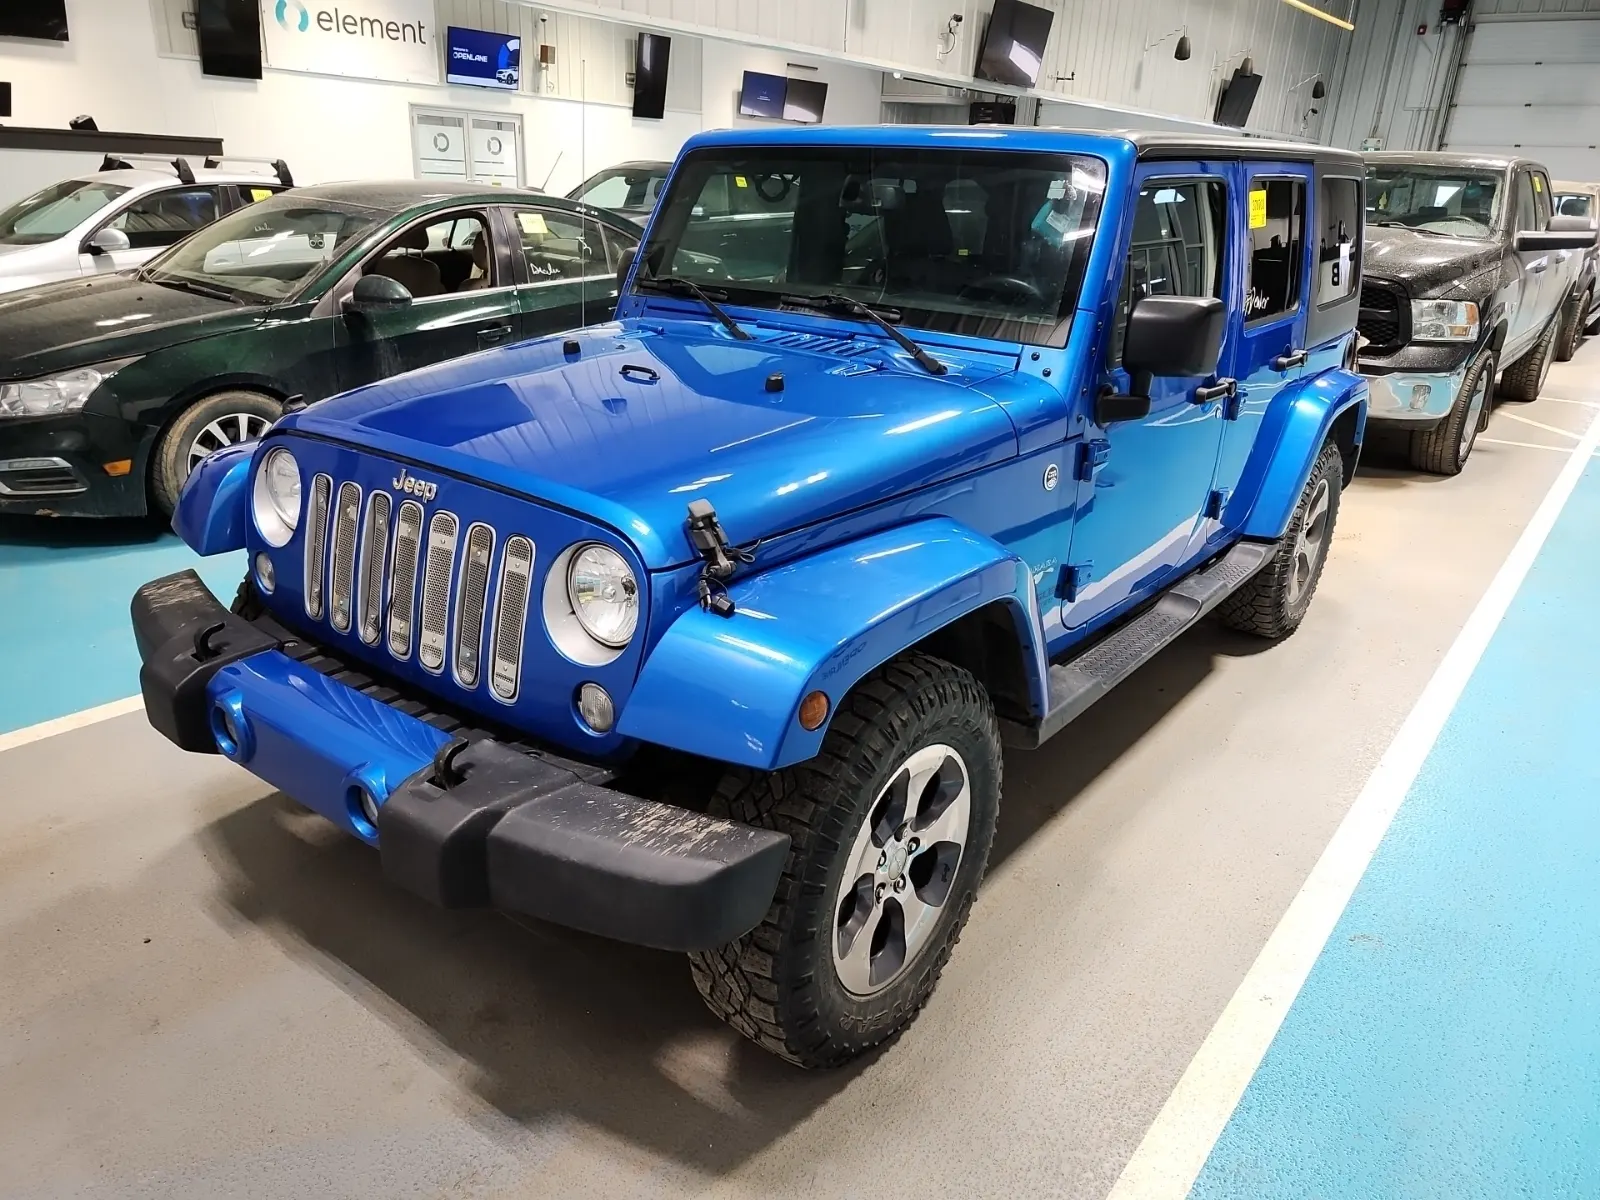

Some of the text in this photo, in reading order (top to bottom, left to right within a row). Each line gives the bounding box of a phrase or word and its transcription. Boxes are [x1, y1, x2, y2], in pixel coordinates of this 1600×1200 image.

[316, 8, 427, 45] element
[453, 51, 488, 63] OPENLANE
[392, 468, 439, 503] Jeep
